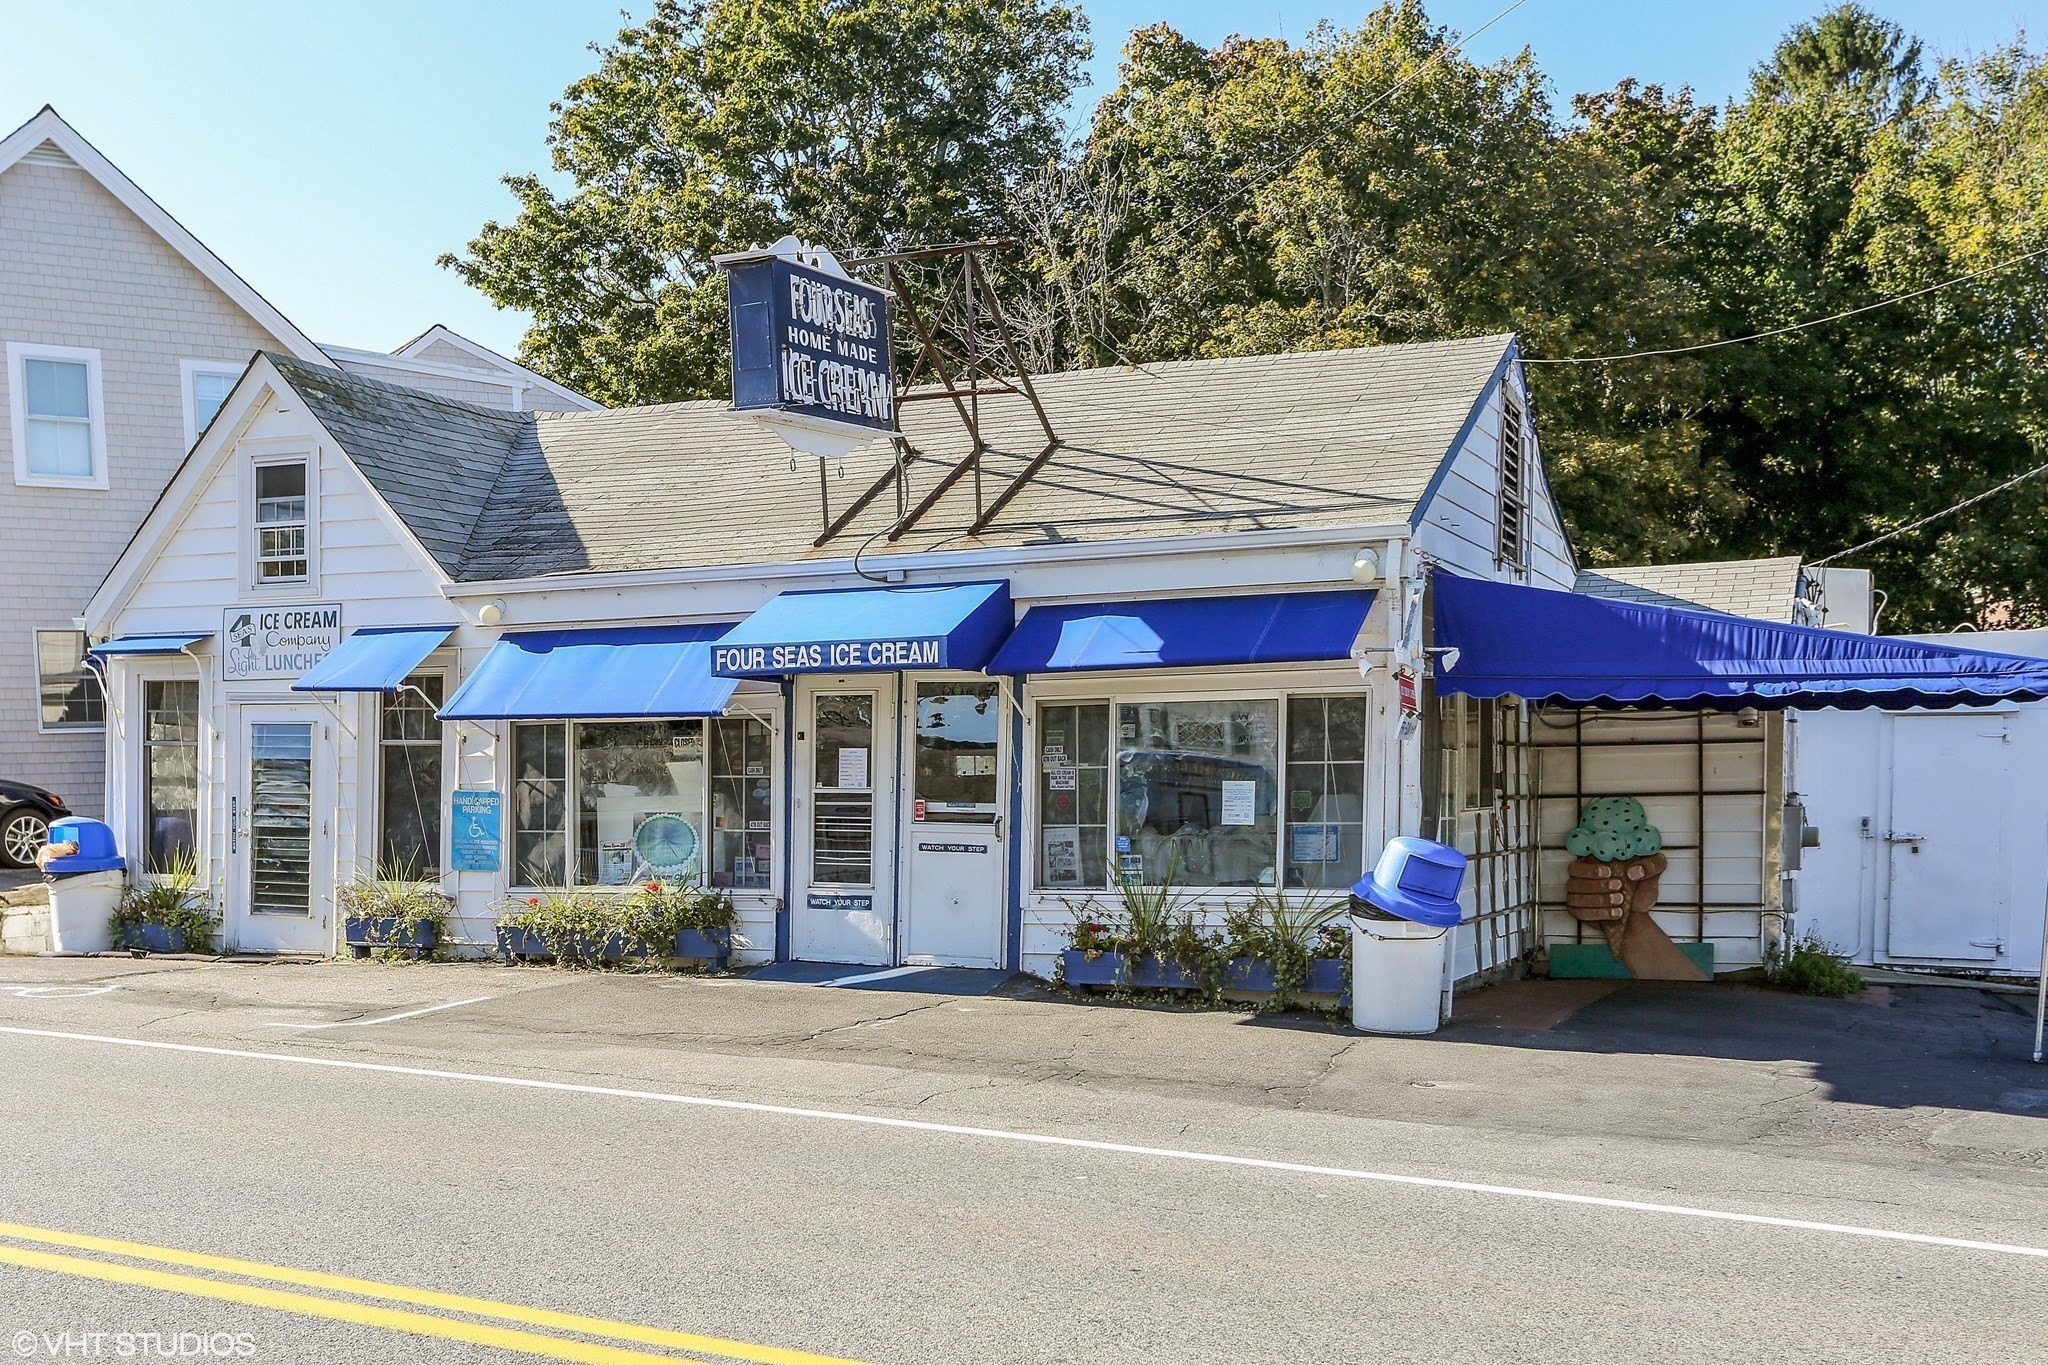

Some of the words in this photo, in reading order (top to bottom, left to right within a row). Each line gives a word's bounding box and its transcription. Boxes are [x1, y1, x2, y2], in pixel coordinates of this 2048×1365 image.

[789, 274, 833, 328] FOUR
[788, 326, 831, 352] HOME
[836, 339, 877, 364] MADE
[781, 349, 816, 404] ICE
[818, 358, 892, 420] CREAM
[229, 614, 252, 647] 4
[233, 625, 253, 641] SEAS
[260, 613, 280, 630] ICE
[284, 610, 337, 629] CREAM
[265, 631, 331, 651] Company
[716, 647, 766, 671] FOUR
[771, 644, 822, 668] SEAS
[830, 643, 861, 665] ICE
[867, 641, 939, 666] CREAM
[228, 647, 260, 677] Light
[265, 652, 330, 671] LUNCHE
[462, 805, 491, 814] PARKING
[809, 898, 832, 906] WATCH
[833, 898, 851, 906] YOUR
[853, 898, 870, 907] STEP
